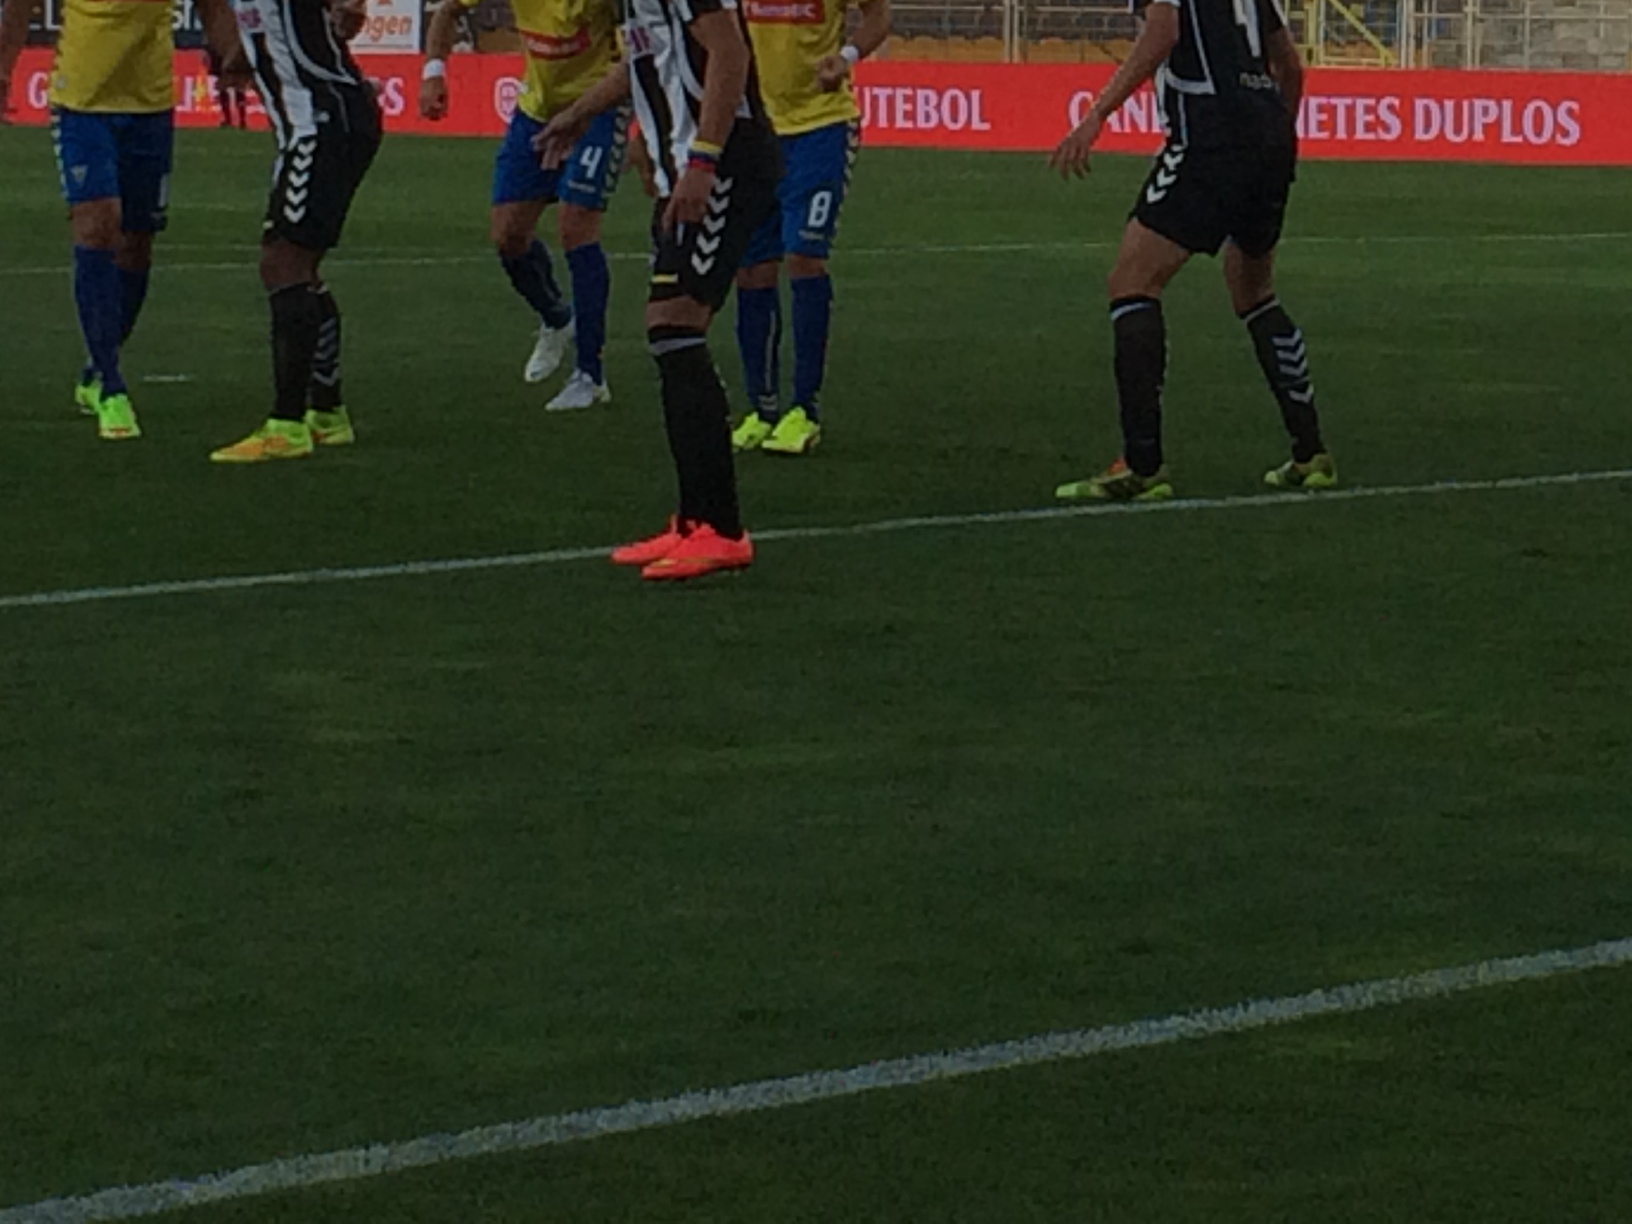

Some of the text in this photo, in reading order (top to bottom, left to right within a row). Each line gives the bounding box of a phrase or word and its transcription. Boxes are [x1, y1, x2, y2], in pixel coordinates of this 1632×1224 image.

[853, 86, 991, 130] UTEBOL
[1413, 96, 1581, 146] DUPLOS
[808, 190, 832, 228] 8
